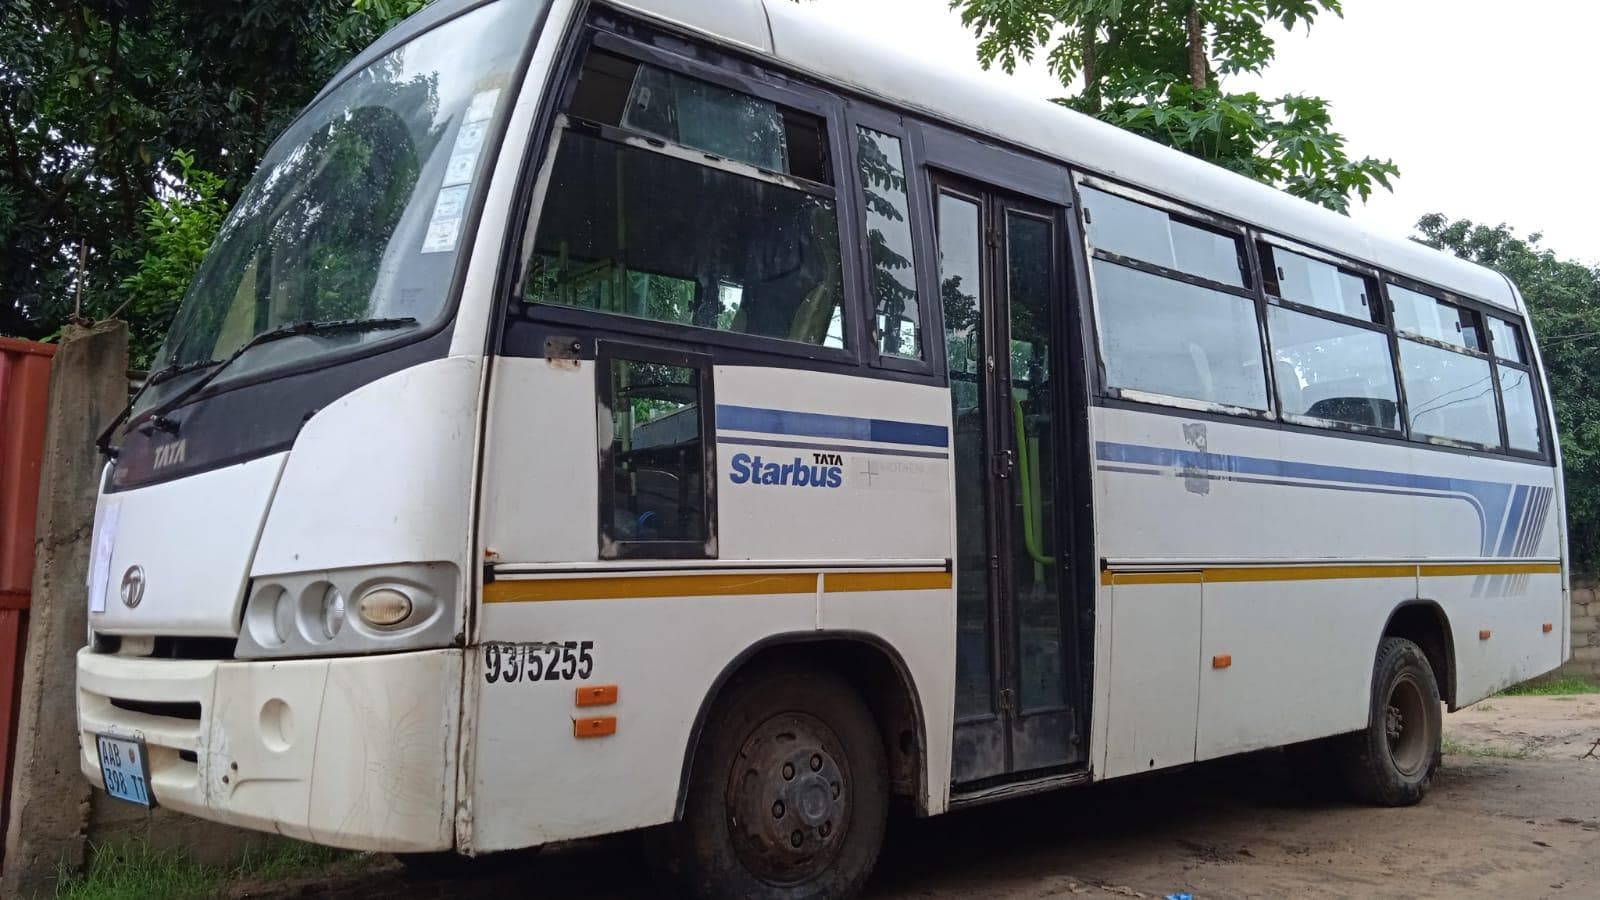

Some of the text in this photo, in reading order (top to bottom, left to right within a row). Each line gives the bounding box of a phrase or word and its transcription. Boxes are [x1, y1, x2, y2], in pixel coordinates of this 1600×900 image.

[153, 438, 187, 470] TATA
[812, 453, 843, 466] TATA
[729, 453, 842, 488] Starbus
[484, 641, 594, 683] 93/5255
[102, 741, 121, 767] AAB
[105, 768, 146, 801] 398 TT
